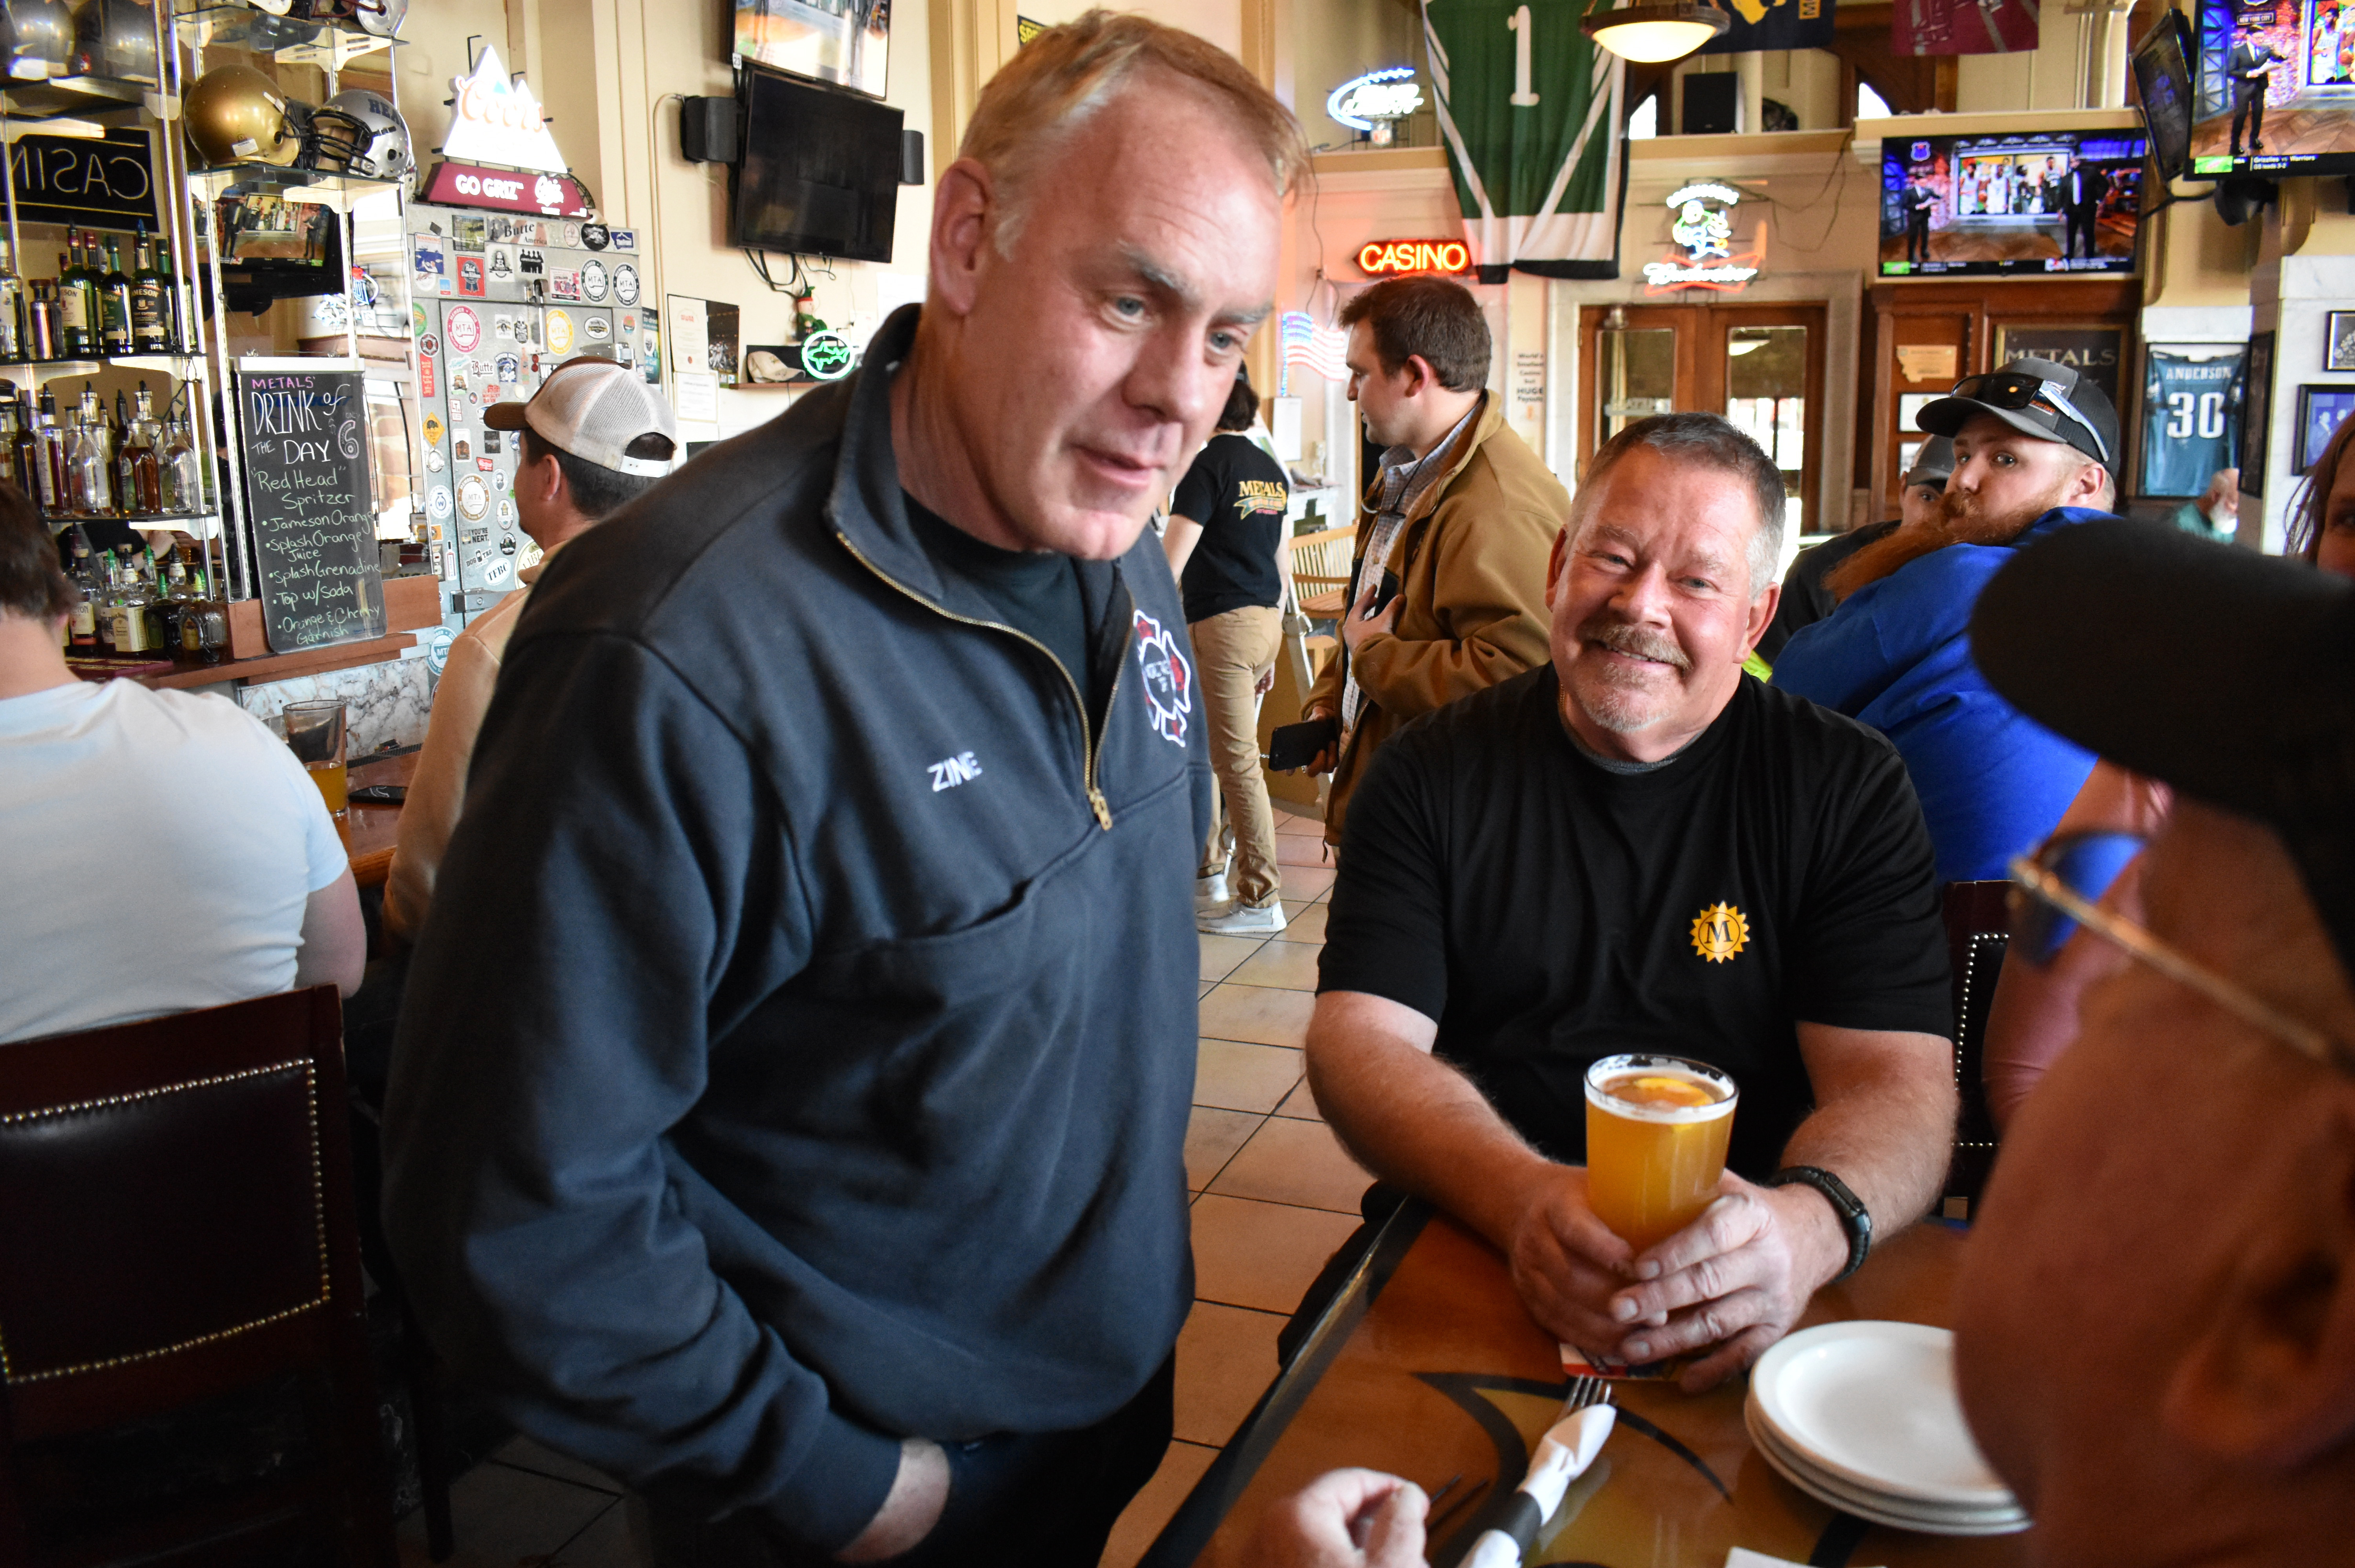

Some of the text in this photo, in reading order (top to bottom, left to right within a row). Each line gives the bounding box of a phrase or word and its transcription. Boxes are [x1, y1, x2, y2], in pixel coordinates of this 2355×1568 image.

[732, 56, 742, 67] 23
[1508, 5, 1540, 106] 1
[456, 174, 481, 196] GO
[504, 224, 535, 237] Butte
[524, 236, 547, 245] America
[1360, 243, 1470, 272] CASINO
[456, 324, 472, 333] MTA
[471, 360, 493, 373] Butte
[2166, 366, 2232, 380] ANDERSON
[251, 390, 323, 435] DRINK
[323, 384, 351, 416] of
[2167, 392, 2225, 438] 30
[251, 439, 331, 465] THE DAY
[1238, 480, 1284, 498] METALS
[281, 490, 356, 516] Spritzer
[269, 509, 375, 535] Jameson Orange
[270, 530, 363, 555] Splash Orange
[287, 548, 322, 562] Juice
[273, 558, 382, 587] Splash Grenadine
[487, 563, 508, 582] TFBC
[276, 592, 299, 612] Top
[335, 605, 380, 625] Cherry
[297, 625, 349, 645] Garnish
[1704, 920, 1734, 944] M
